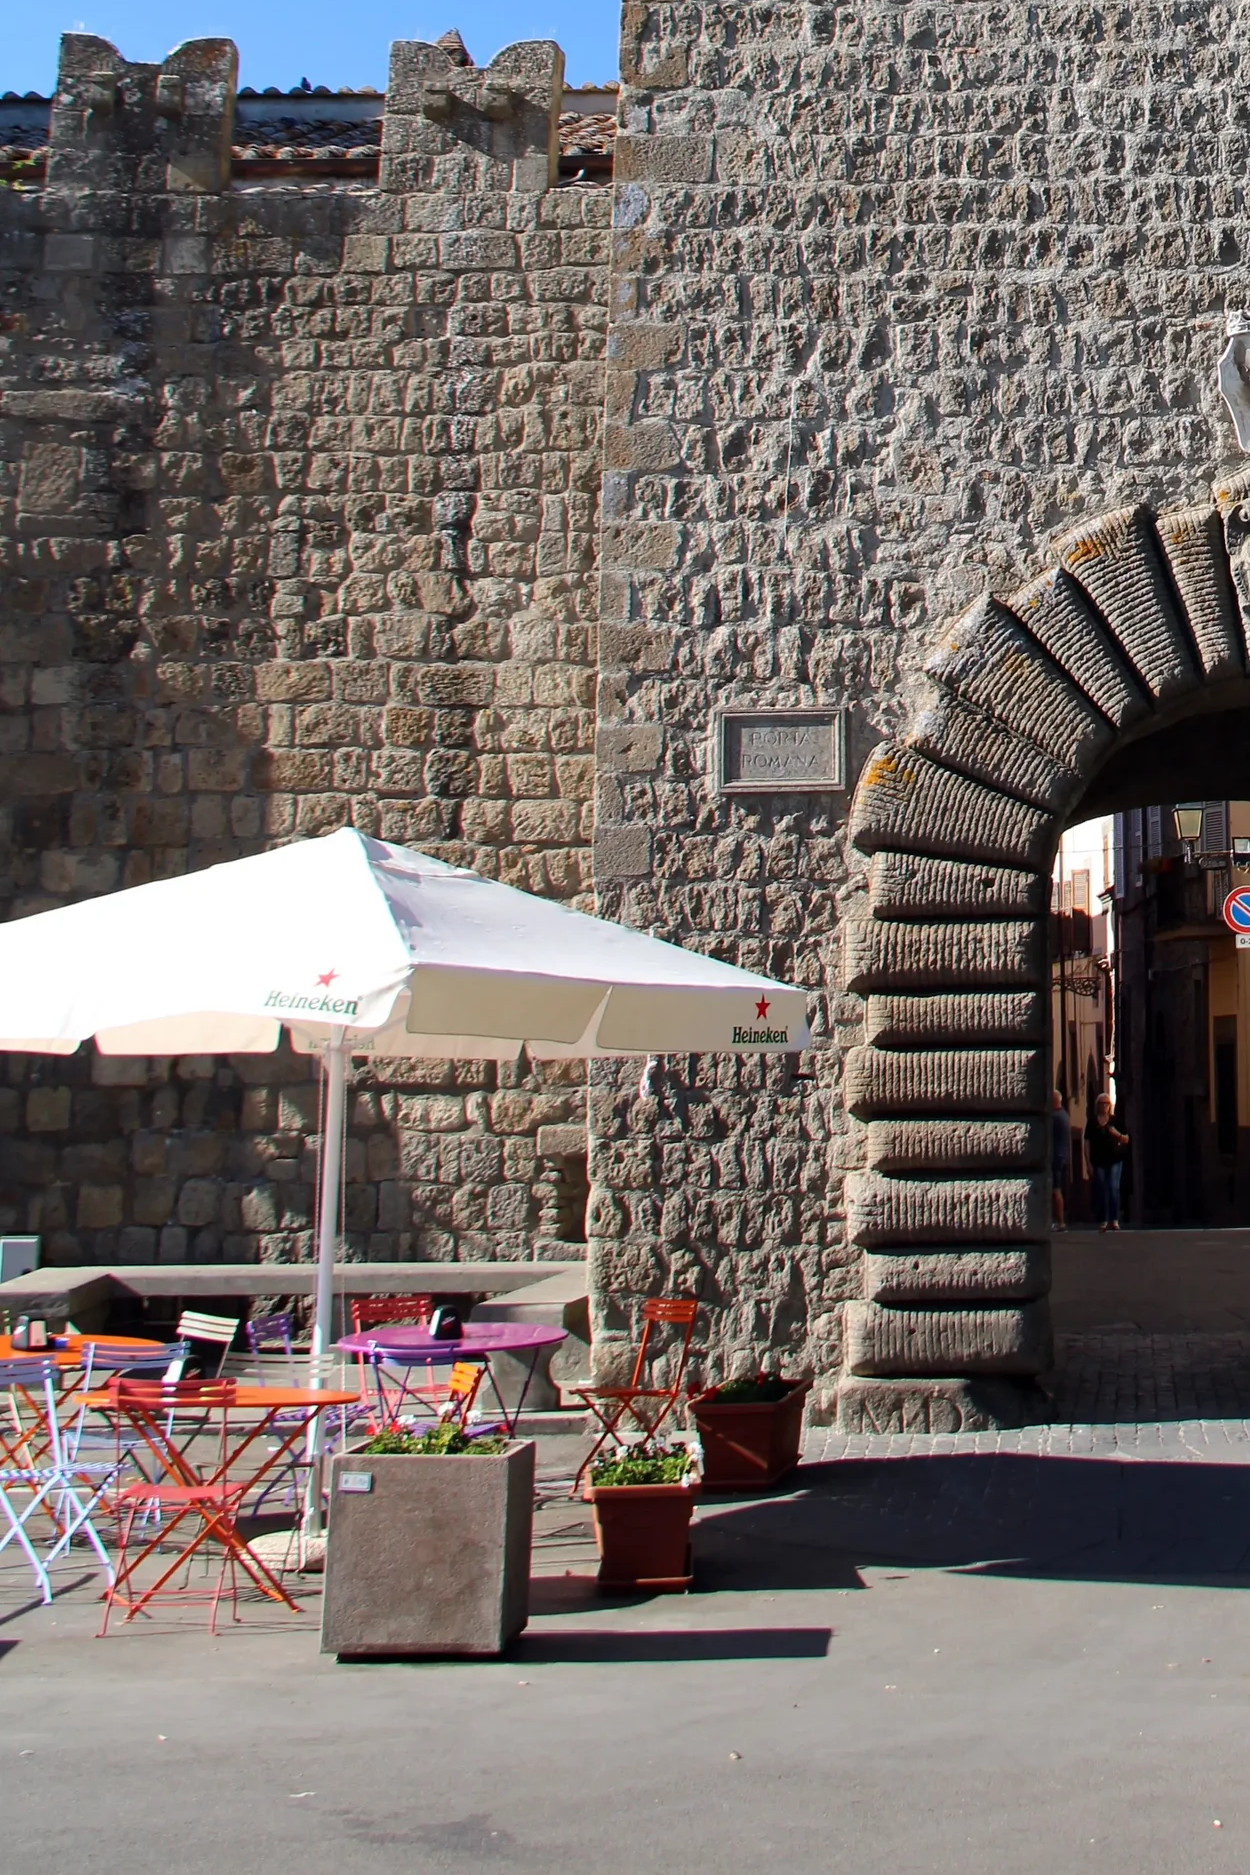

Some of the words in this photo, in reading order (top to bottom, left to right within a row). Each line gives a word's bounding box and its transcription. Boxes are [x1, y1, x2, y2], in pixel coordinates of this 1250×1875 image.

[751, 731, 813, 747] PORTA
[741, 753, 820, 770] ROMANA
[264, 990, 359, 1015] Heineken
[732, 1026, 788, 1043] Heineken
